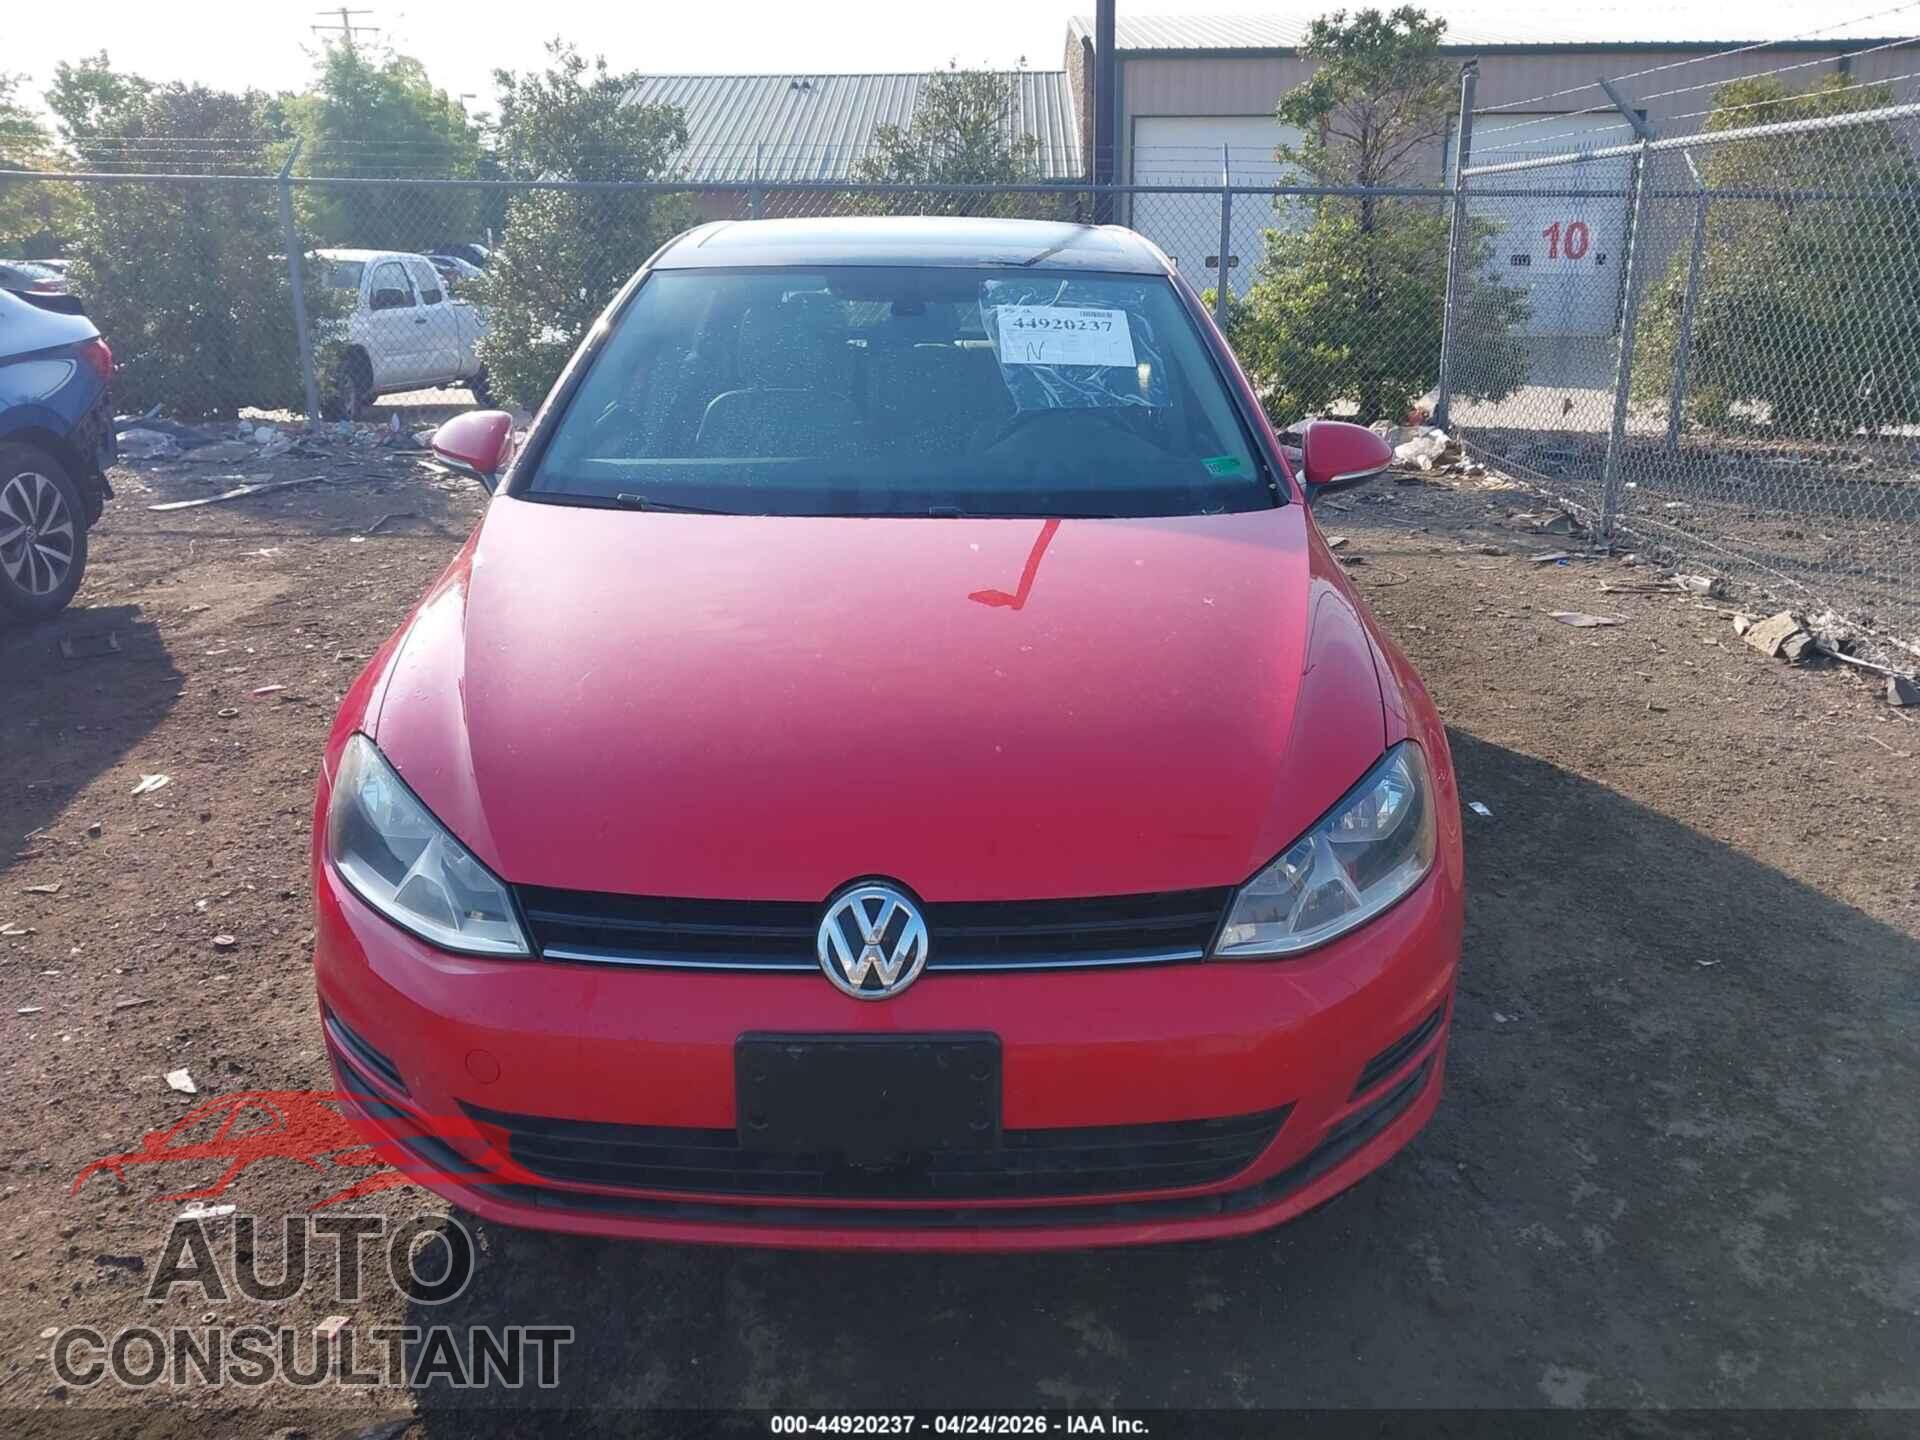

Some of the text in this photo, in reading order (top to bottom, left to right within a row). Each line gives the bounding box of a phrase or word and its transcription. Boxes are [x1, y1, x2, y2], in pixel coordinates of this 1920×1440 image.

[1542, 221, 1590, 260] 10
[1012, 317, 1112, 332] 44920237
[1026, 341, 1045, 361] N
[817, 886, 928, 1000] VW
